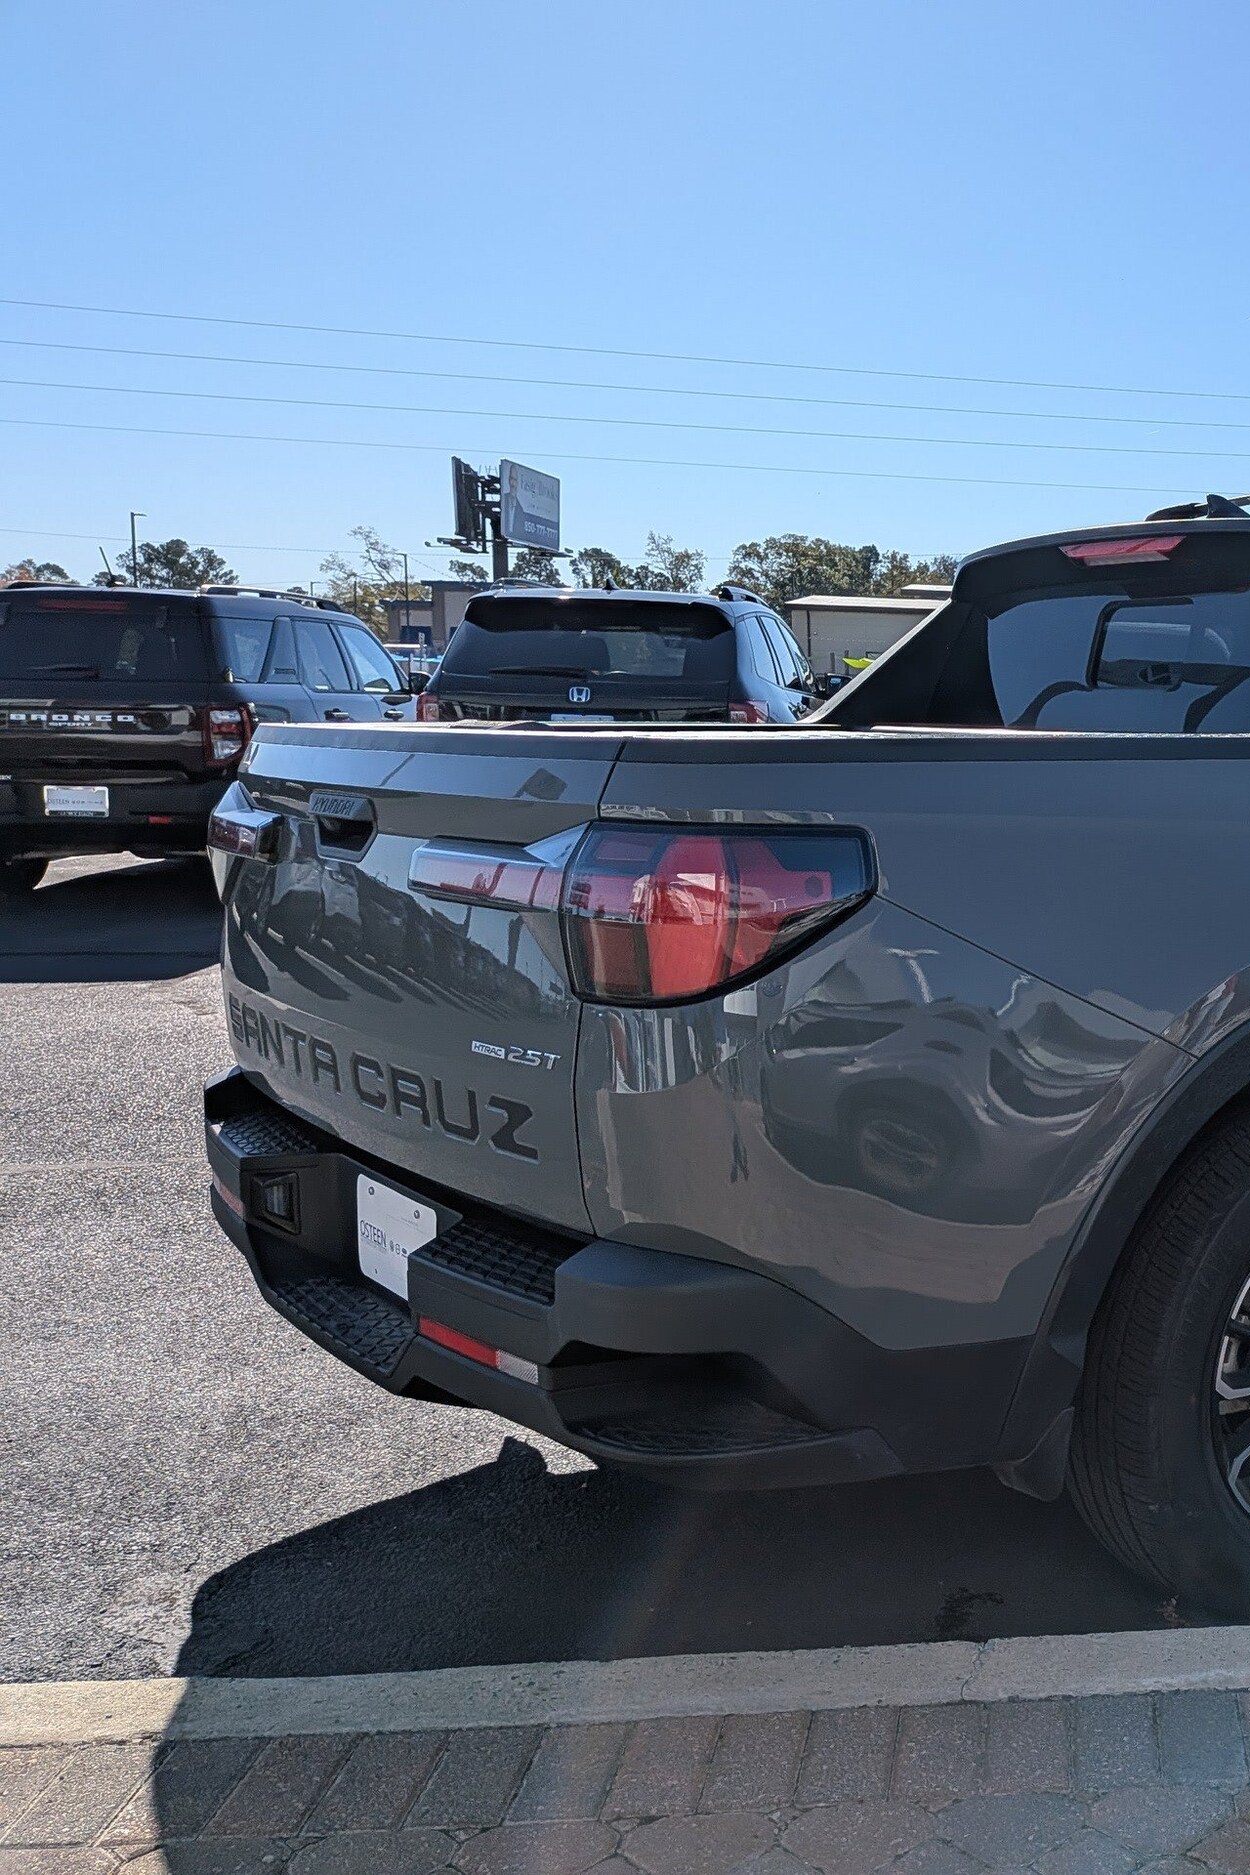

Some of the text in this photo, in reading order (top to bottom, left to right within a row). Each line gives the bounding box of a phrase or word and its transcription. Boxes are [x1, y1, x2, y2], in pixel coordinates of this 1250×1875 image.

[9, 712, 135, 723] BRONCO
[311, 796, 355, 816] HYUNDAI
[473, 1042, 503, 1058] HTRAC
[229, 991, 540, 1164] SANTA CRUZ
[359, 1219, 387, 1248] OSTEEN
